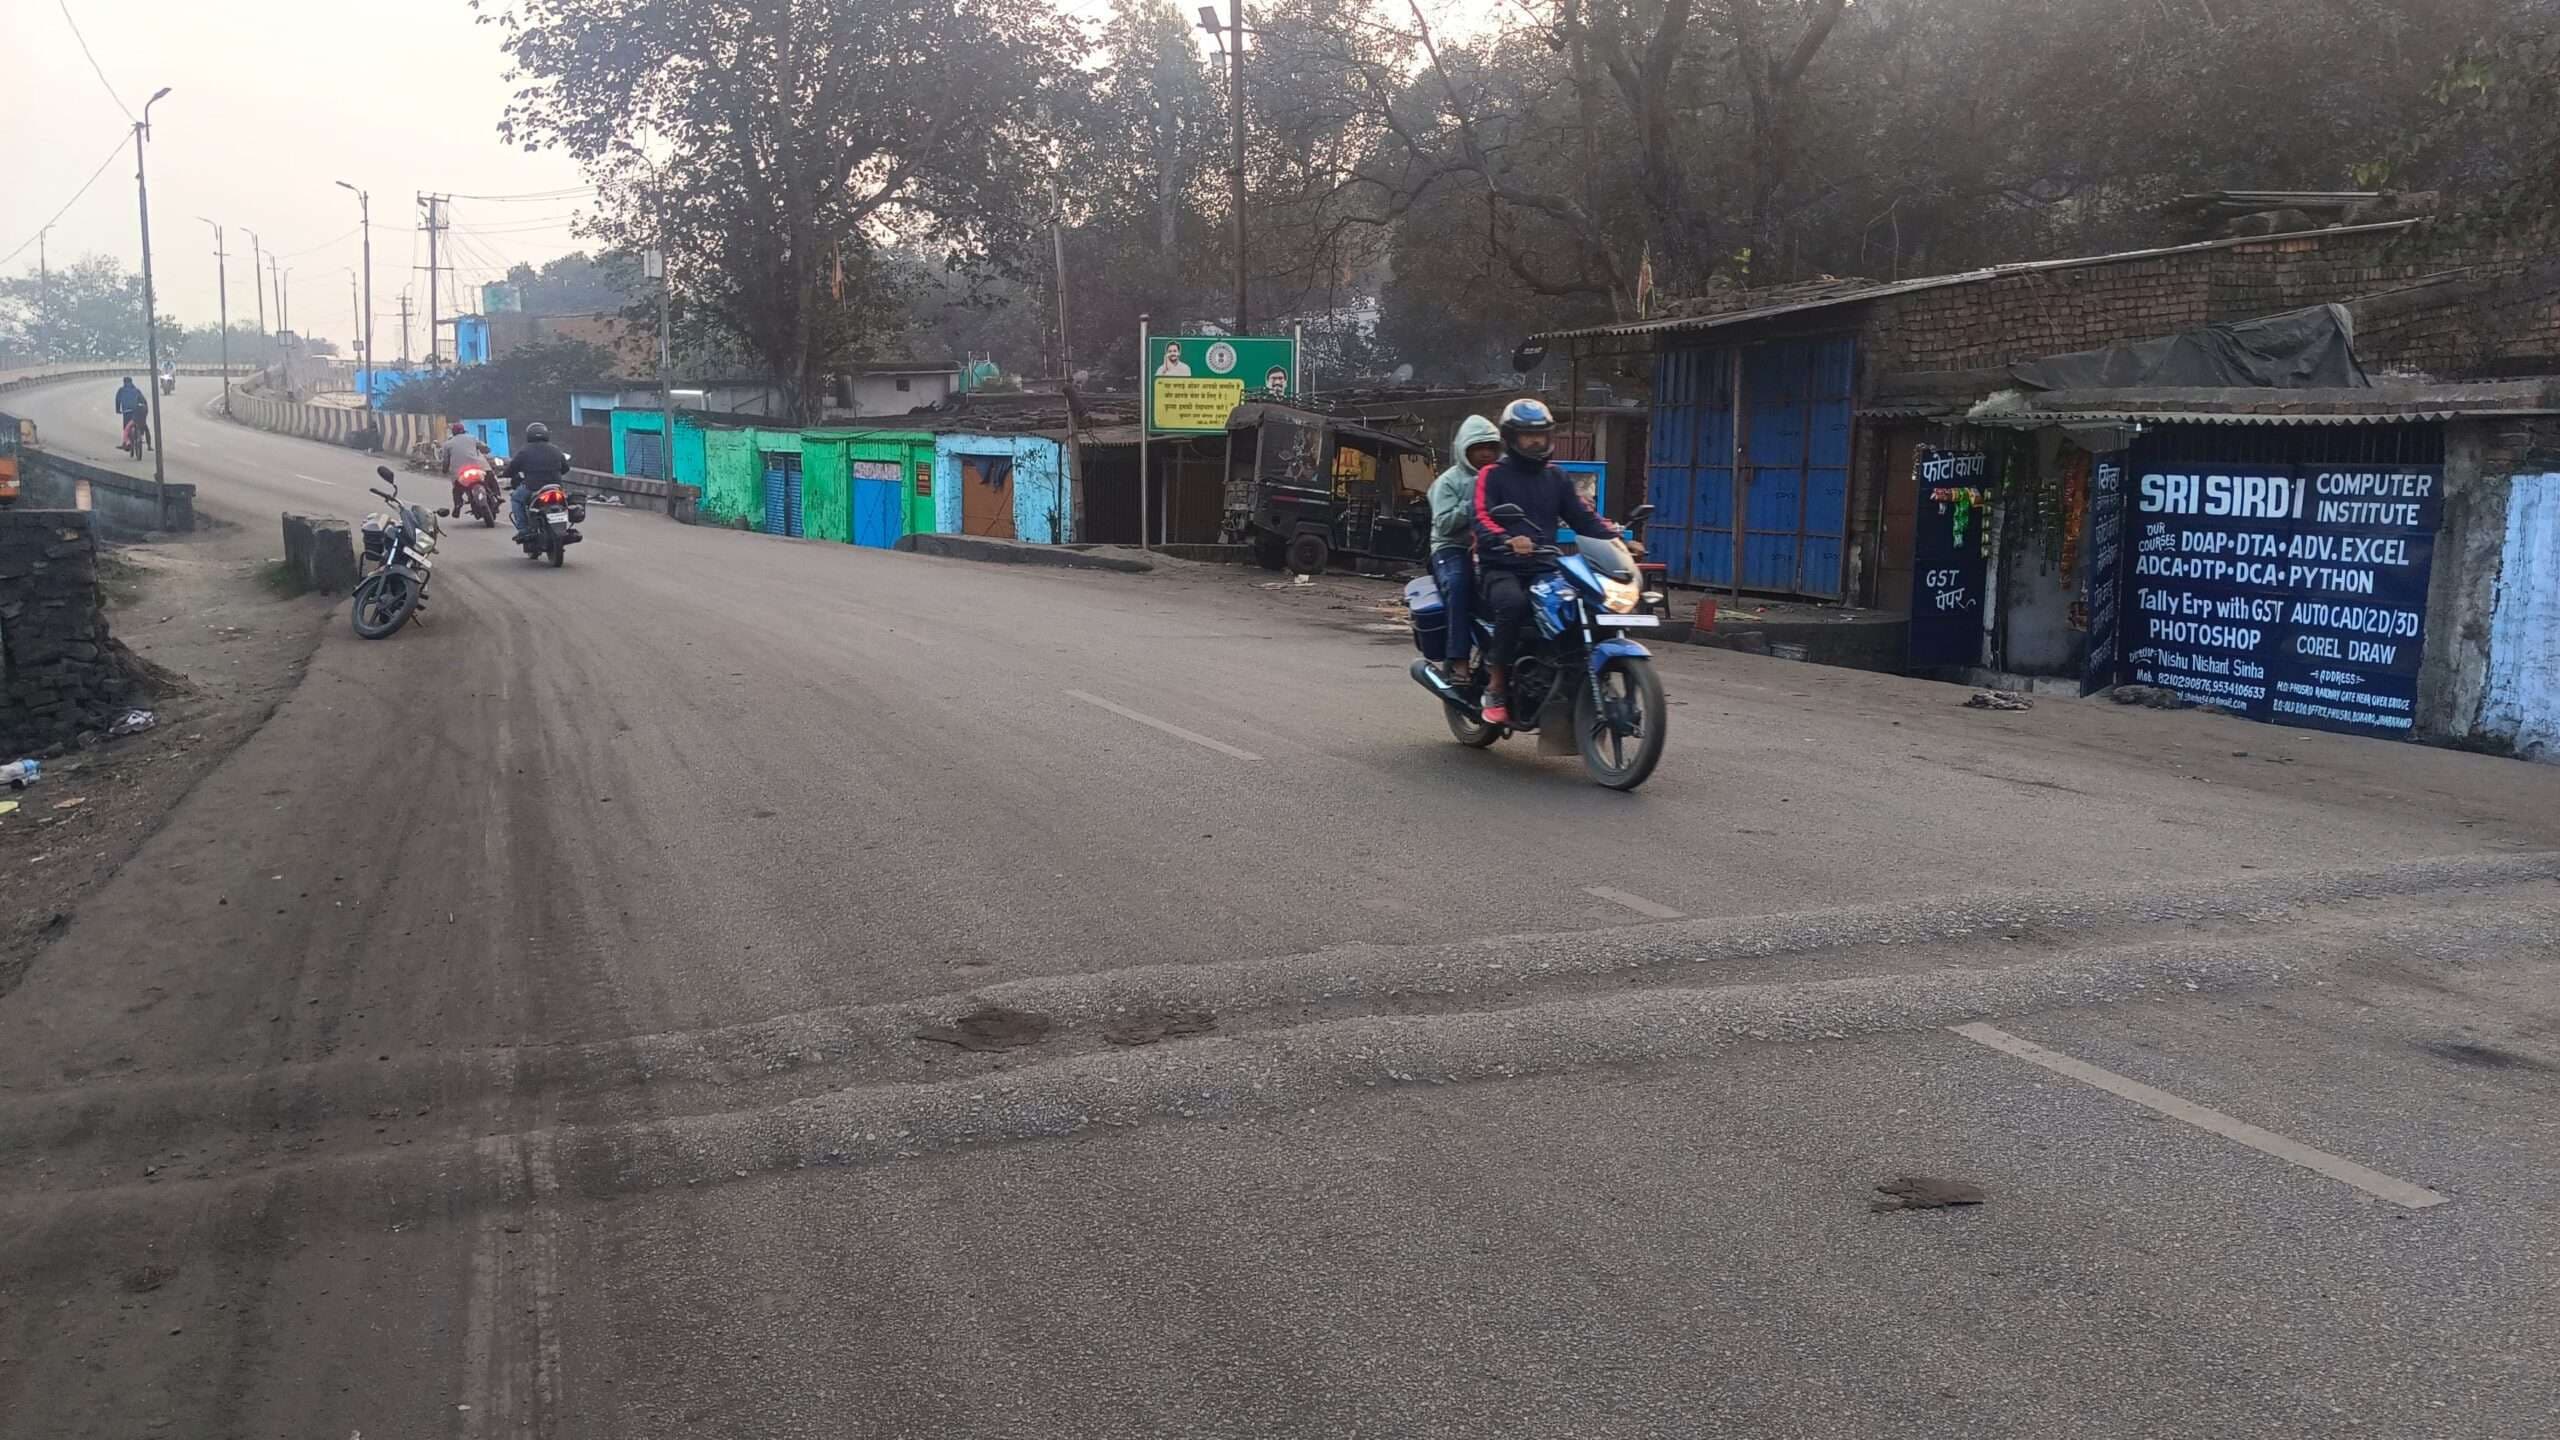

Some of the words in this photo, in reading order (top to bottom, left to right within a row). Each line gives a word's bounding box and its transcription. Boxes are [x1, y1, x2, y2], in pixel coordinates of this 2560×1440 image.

[1923, 452, 1955, 482] फोटो
[2139, 475, 2199, 514] SRI
[2205, 476, 2305, 519] SIRDI
[2316, 473, 2433, 497] COMPUTER
[2317, 500, 2420, 526] INSTITUTE
[2138, 533, 2176, 552] COURSES
[2146, 522, 2166, 536] OUR
[1926, 569, 1960, 587] GST
[2288, 566, 2374, 595] PYTHON
[1936, 588, 1973, 610] पेपर
[2138, 587, 2179, 616] Tally
[2183, 592, 2212, 618] Erp
[2216, 596, 2249, 621] with
[2252, 599, 2284, 624] GST
[2150, 618, 2261, 651] PHOTOSHOP
[2158, 648, 2188, 671] Nishu
[2192, 654, 2229, 675] Nishant
[2233, 659, 2264, 679] Sinha
[2296, 635, 2341, 659] COREL
[2348, 640, 2396, 665] DRAW
